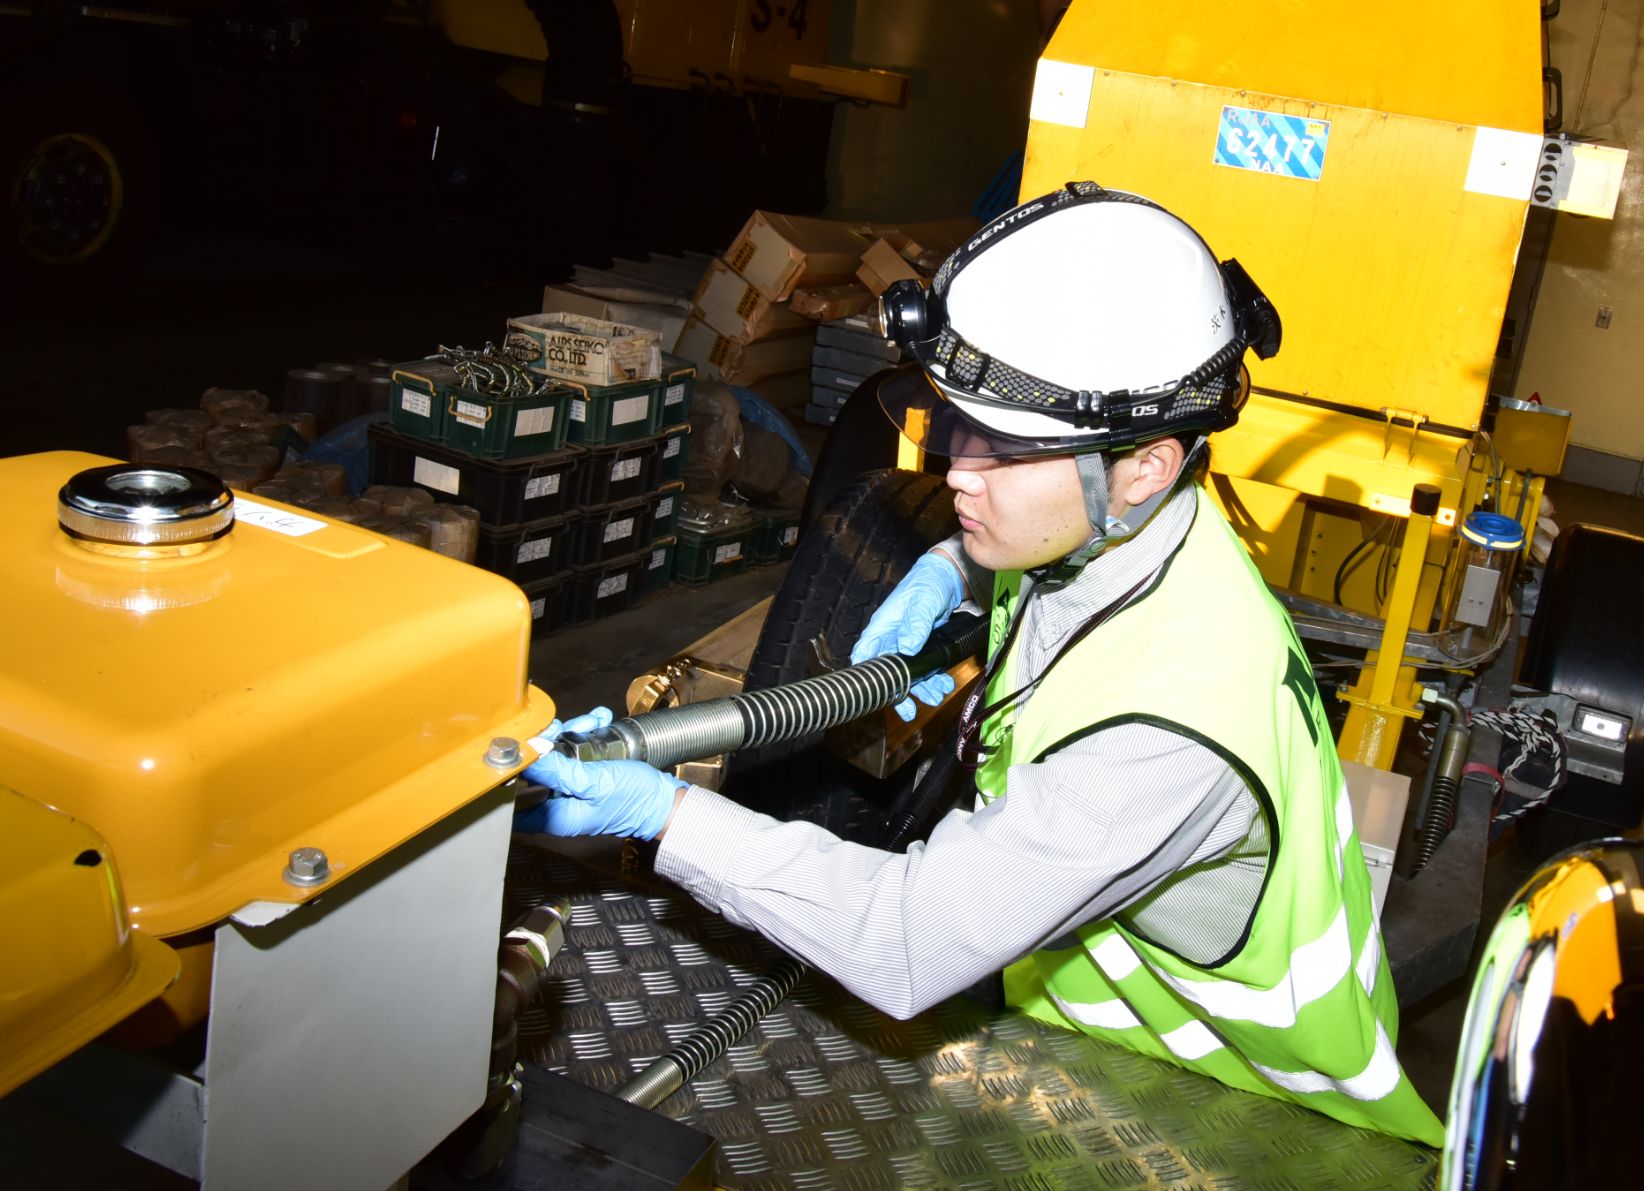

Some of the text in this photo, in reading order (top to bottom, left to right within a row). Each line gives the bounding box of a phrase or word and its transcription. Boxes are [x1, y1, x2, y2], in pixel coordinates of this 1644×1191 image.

[1226, 127, 1315, 165] 62477
[1250, 158, 1284, 174] NAA
[967, 202, 1044, 251] GENTOS
